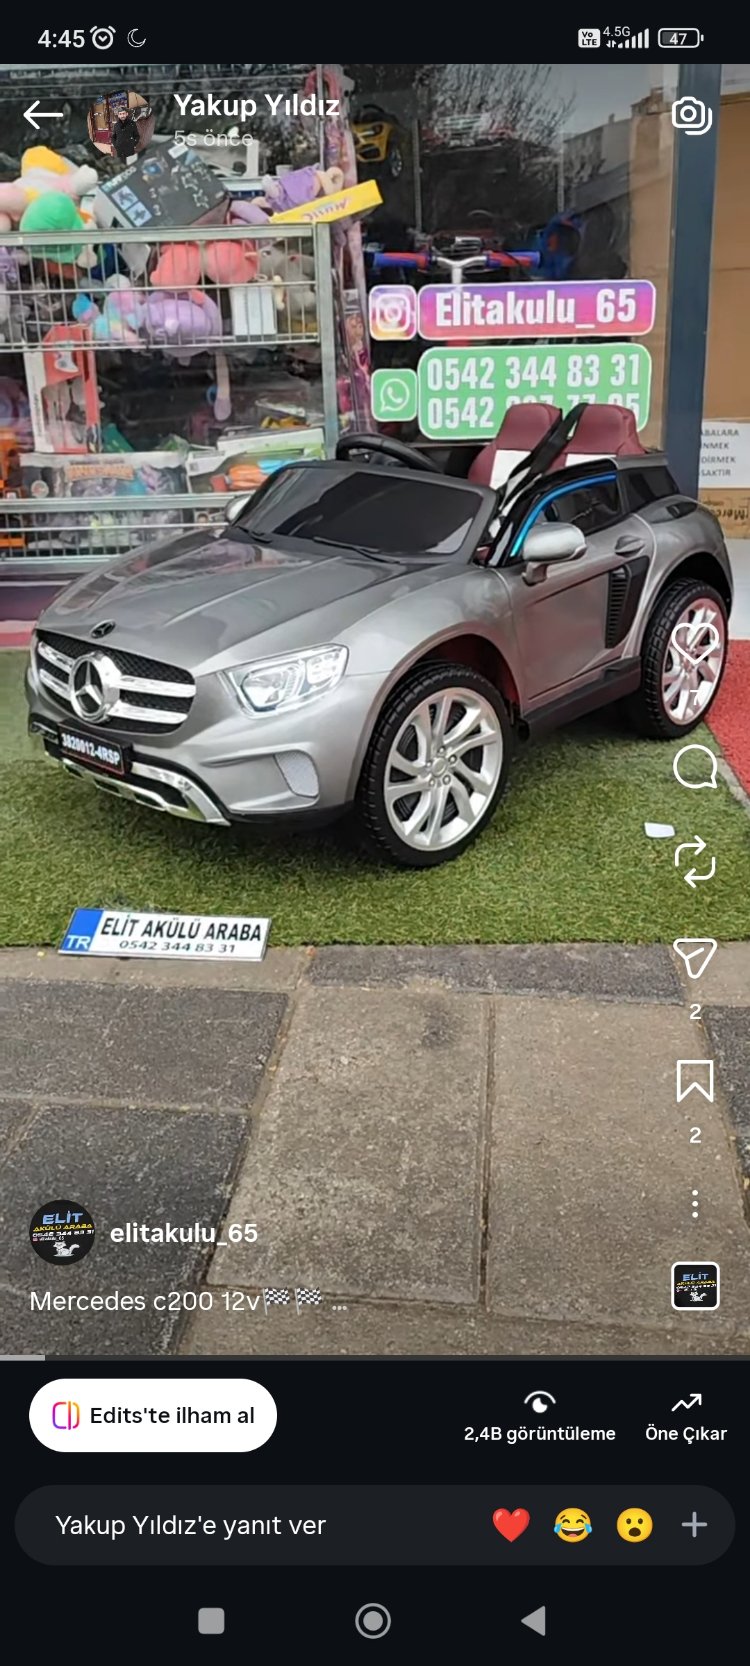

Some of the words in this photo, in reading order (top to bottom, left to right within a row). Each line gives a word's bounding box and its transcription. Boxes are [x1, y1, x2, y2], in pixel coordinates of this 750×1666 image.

[435, 288, 637, 329] Elitakulu_65
[427, 357, 496, 391] 0542
[505, 355, 557, 389] 344
[567, 354, 600, 387] 83
[610, 352, 641, 386] 31
[427, 396, 495, 430] 0542
[65, 935, 91, 949] TR
[101, 915, 140, 937] ELİT
[141, 917, 201, 939] AKÜLÜ
[203, 923, 262, 941] ARABA
[119, 940, 157, 950] 0542
[161, 941, 191, 951] 344
[195, 942, 214, 952] 83
[219, 944, 236, 953] 31
